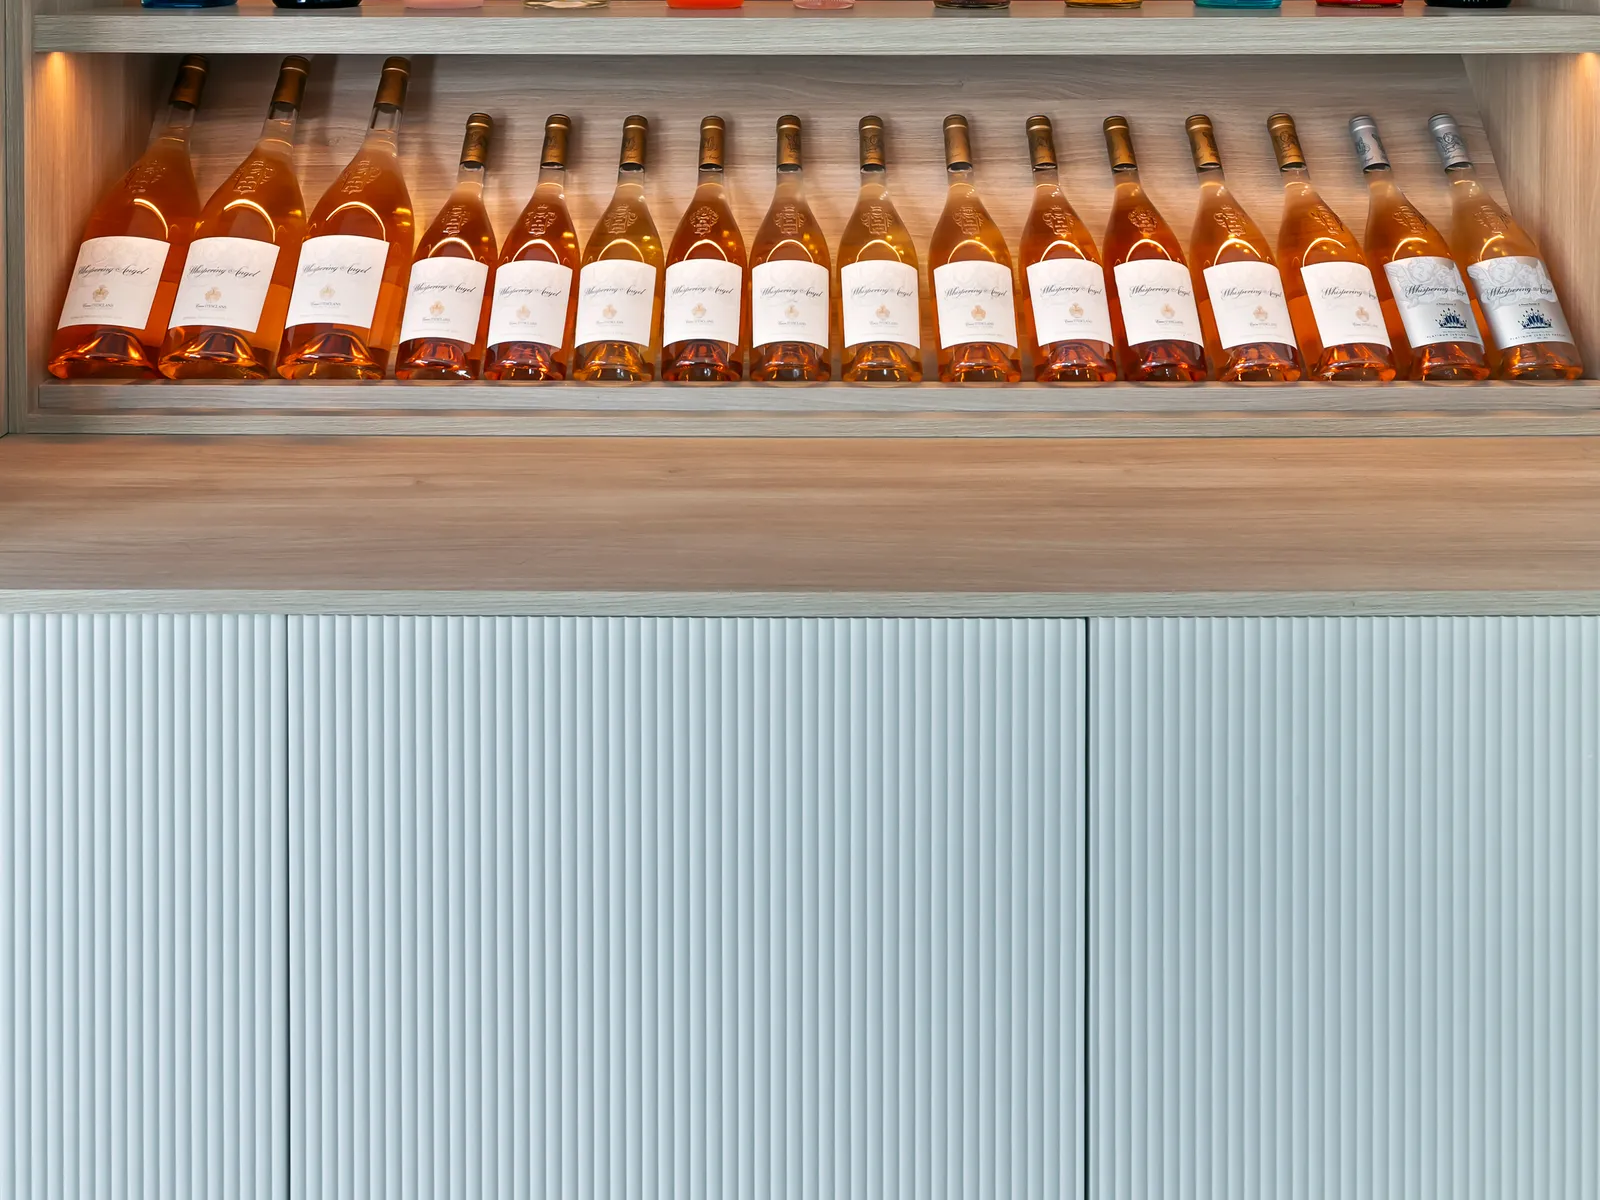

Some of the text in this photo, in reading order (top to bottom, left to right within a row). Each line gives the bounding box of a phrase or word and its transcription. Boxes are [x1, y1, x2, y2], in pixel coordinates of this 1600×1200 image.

[78, 263, 150, 276] Whispering Angel
[189, 264, 261, 278] Whispering Angel
[302, 262, 371, 277] Whispering Angel
[412, 282, 477, 294] Whispering Angel
[498, 285, 561, 298] Whispering Angel
[583, 284, 647, 297] Whispering Angel
[671, 285, 734, 297] Whispering Angel
[760, 285, 824, 298] Whispering Angel
[851, 285, 914, 298] Whispering Angel
[944, 286, 1007, 299] Whispering Angel
[1039, 283, 1103, 298] Whispering Angel
[1129, 285, 1192, 298] Whispering Angel
[1221, 286, 1262, 300] Whispering
[1321, 286, 1363, 300] Whispering
[1405, 284, 1448, 298] Whispering
[1487, 285, 1552, 298] Whispering Angel
